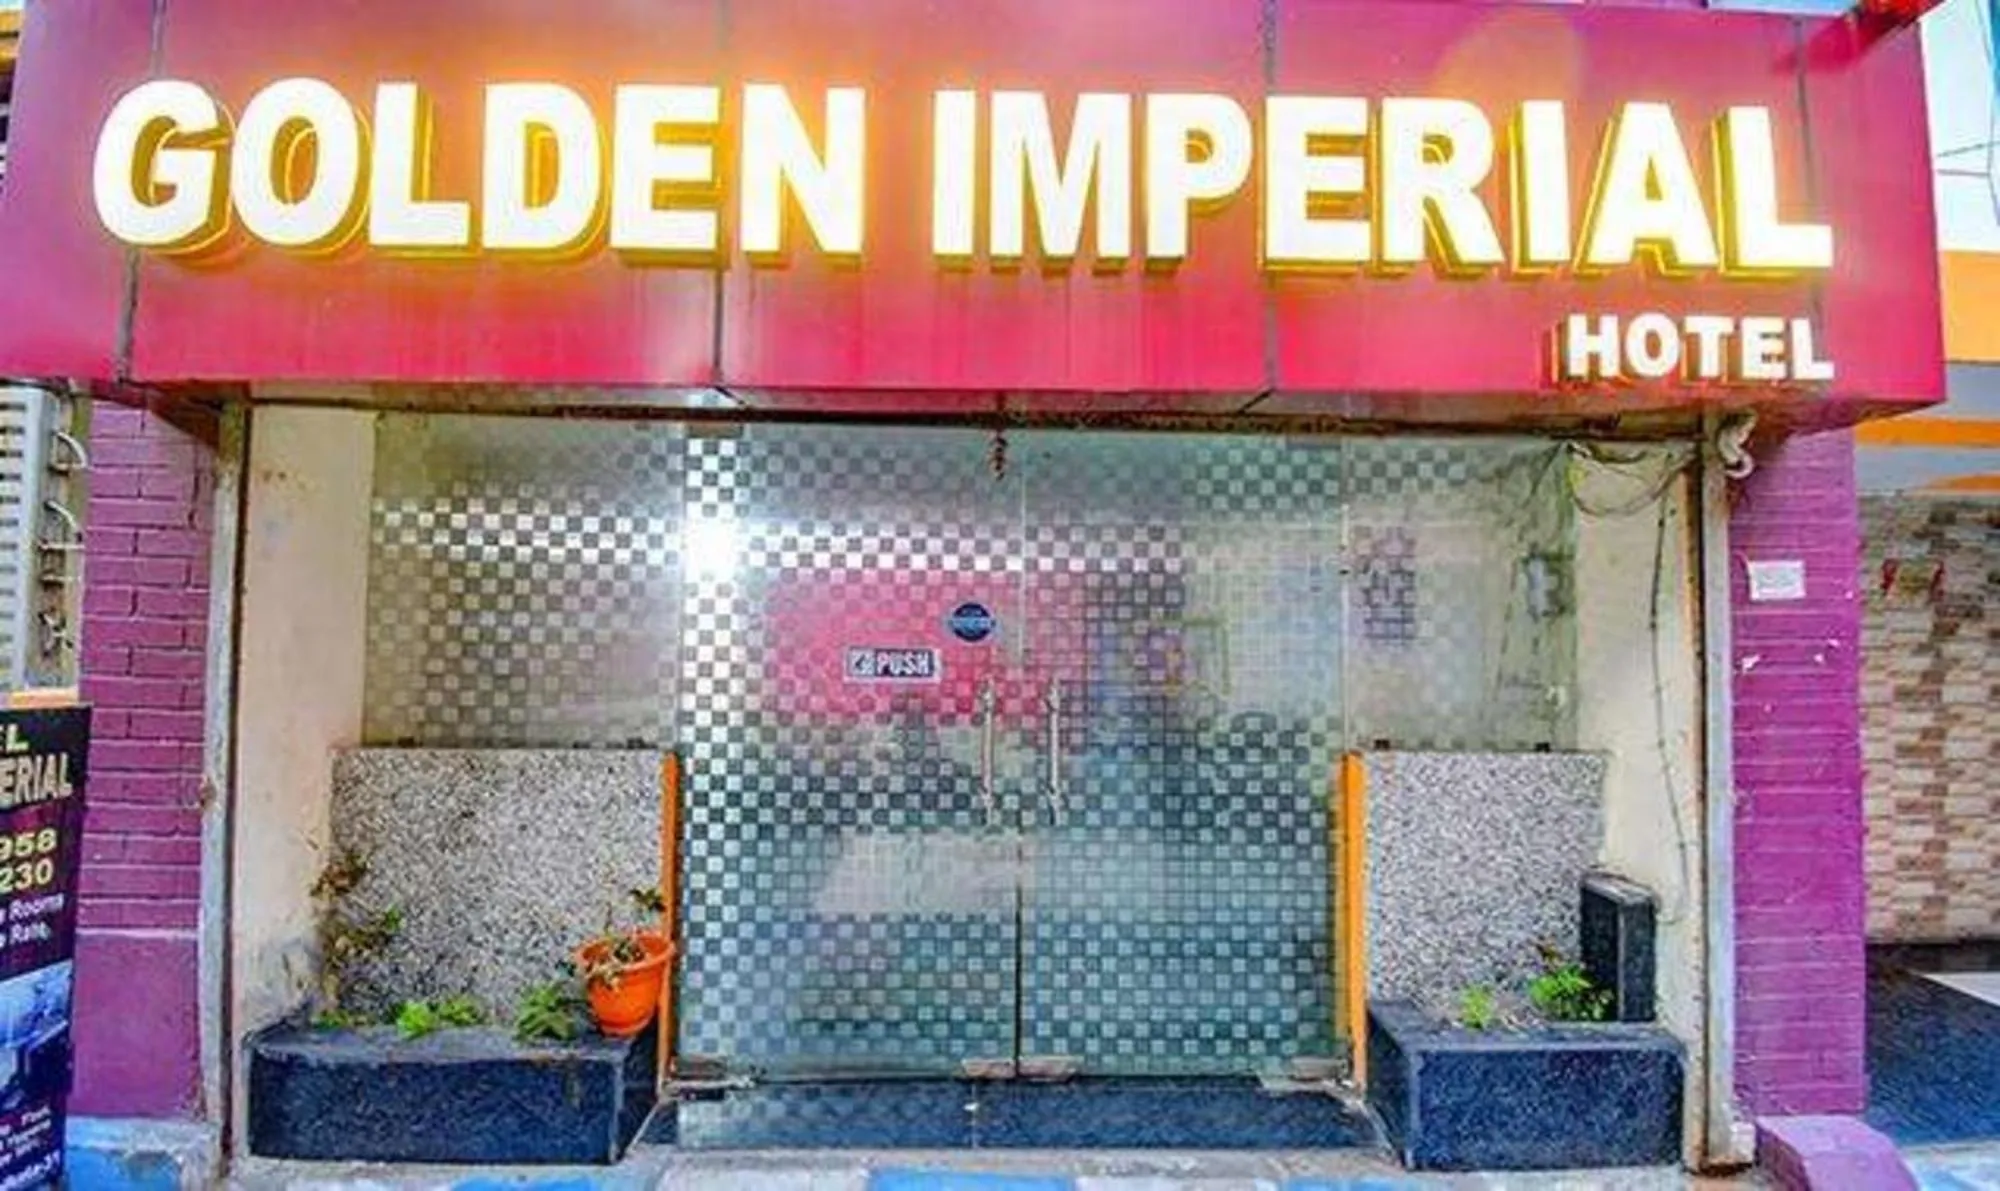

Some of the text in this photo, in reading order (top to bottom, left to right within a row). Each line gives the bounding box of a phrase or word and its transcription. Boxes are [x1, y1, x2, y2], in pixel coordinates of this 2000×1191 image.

[93, 77, 1834, 266] GOLDEN IMPERIAL
[1565, 313, 1835, 381] HOTEL
[876, 652, 930, 676] PUSH
